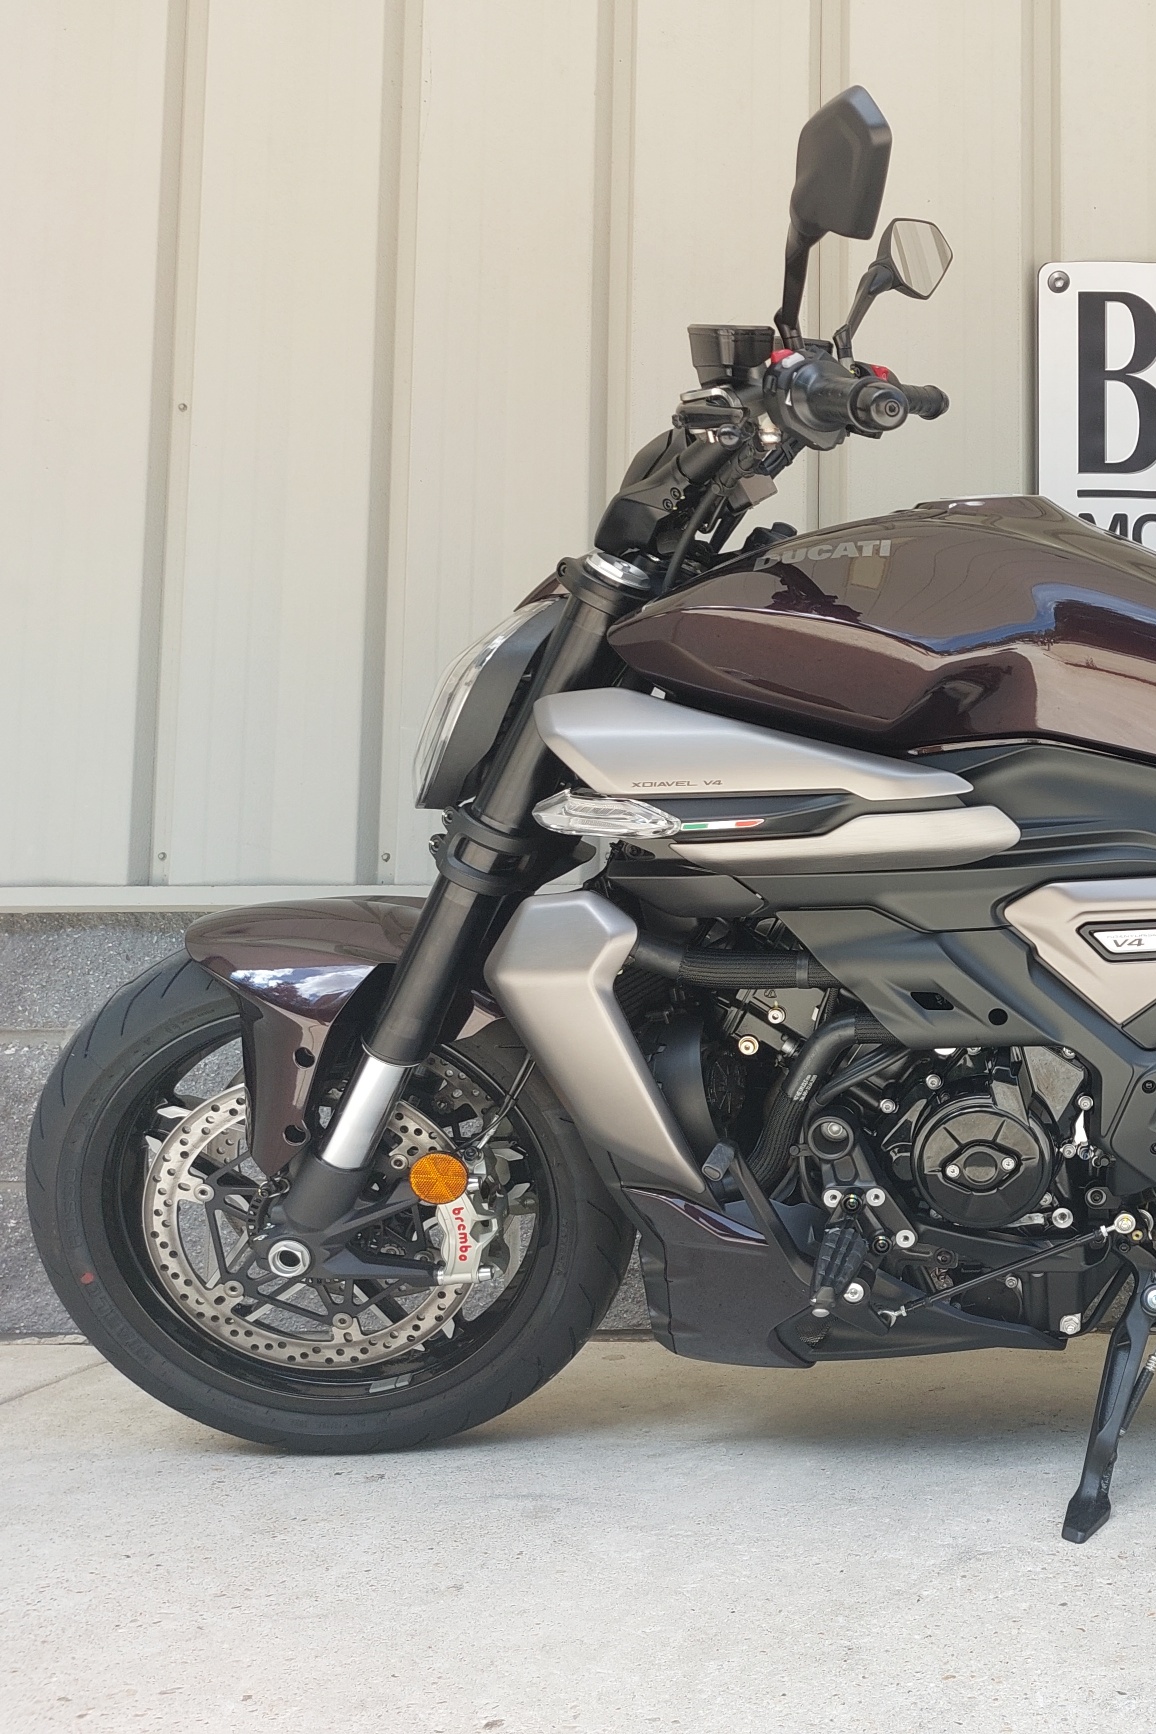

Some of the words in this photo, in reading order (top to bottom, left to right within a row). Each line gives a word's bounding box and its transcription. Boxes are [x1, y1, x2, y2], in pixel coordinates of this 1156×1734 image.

[753, 539, 892, 572] DUCATI
[631, 780, 698, 788] XDIAVEL
[703, 779, 723, 787] V4
[1112, 937, 1145, 948] V4
[451, 1206, 473, 1262] brembo
